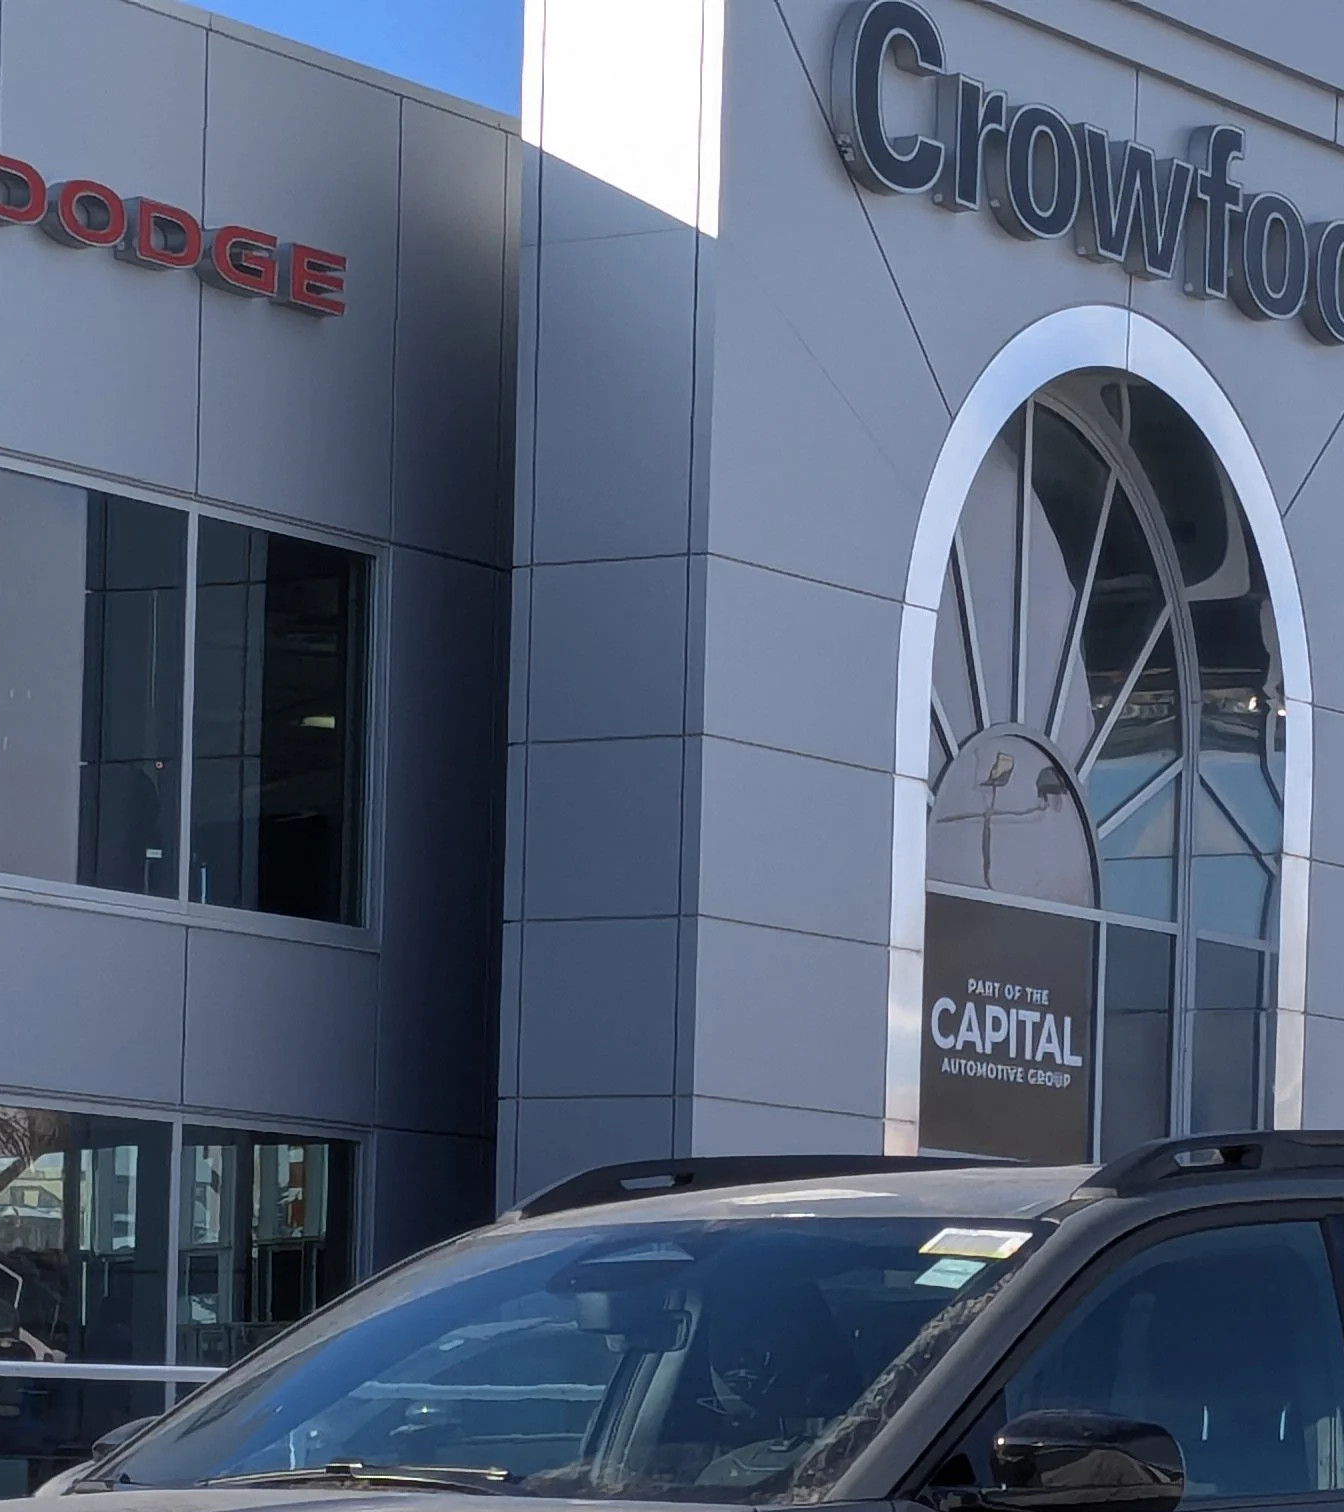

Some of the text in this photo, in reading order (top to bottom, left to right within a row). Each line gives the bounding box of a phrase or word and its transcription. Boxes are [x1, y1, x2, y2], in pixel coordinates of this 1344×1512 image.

[968, 978, 1049, 1006] PART OF THE
[931, 997, 1083, 1067] CAPITAL
[941, 1057, 1071, 1088] AUTOMOTIVE GROUP
